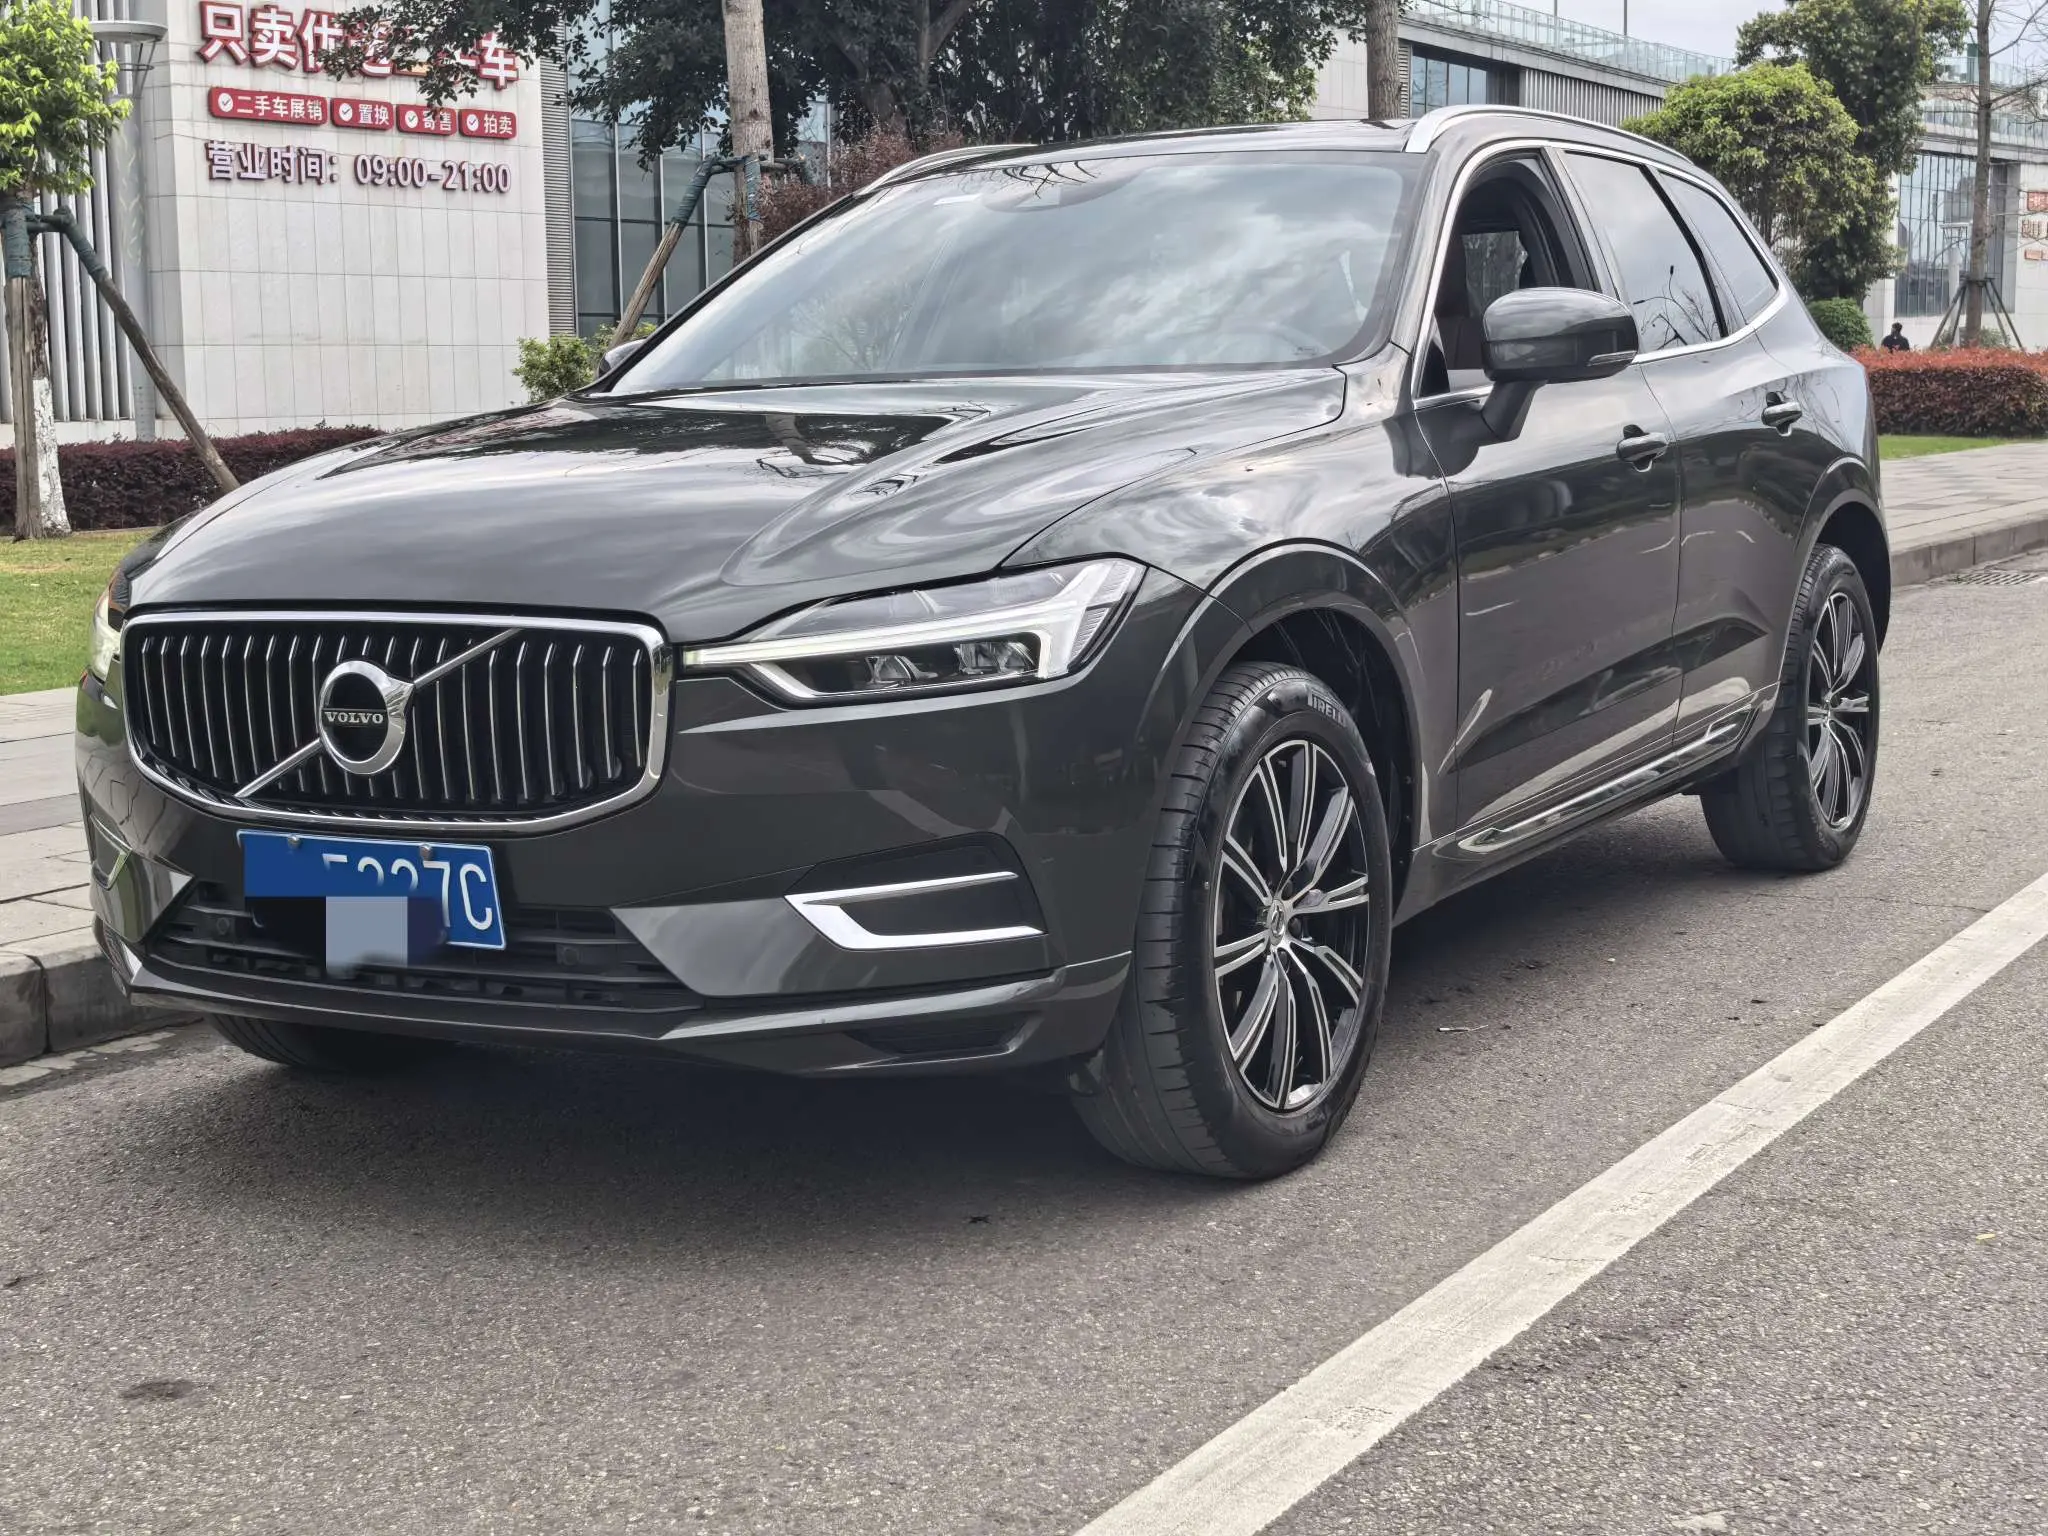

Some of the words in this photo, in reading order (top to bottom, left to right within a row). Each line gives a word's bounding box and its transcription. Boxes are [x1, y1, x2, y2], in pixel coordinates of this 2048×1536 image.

[237, 95, 323, 121] 二手车展销
[358, 103, 391, 127] 置换
[483, 112, 513, 135] 拍卖
[355, 154, 512, 193] 09:00-21:00
[324, 711, 384, 724] VOLVO
